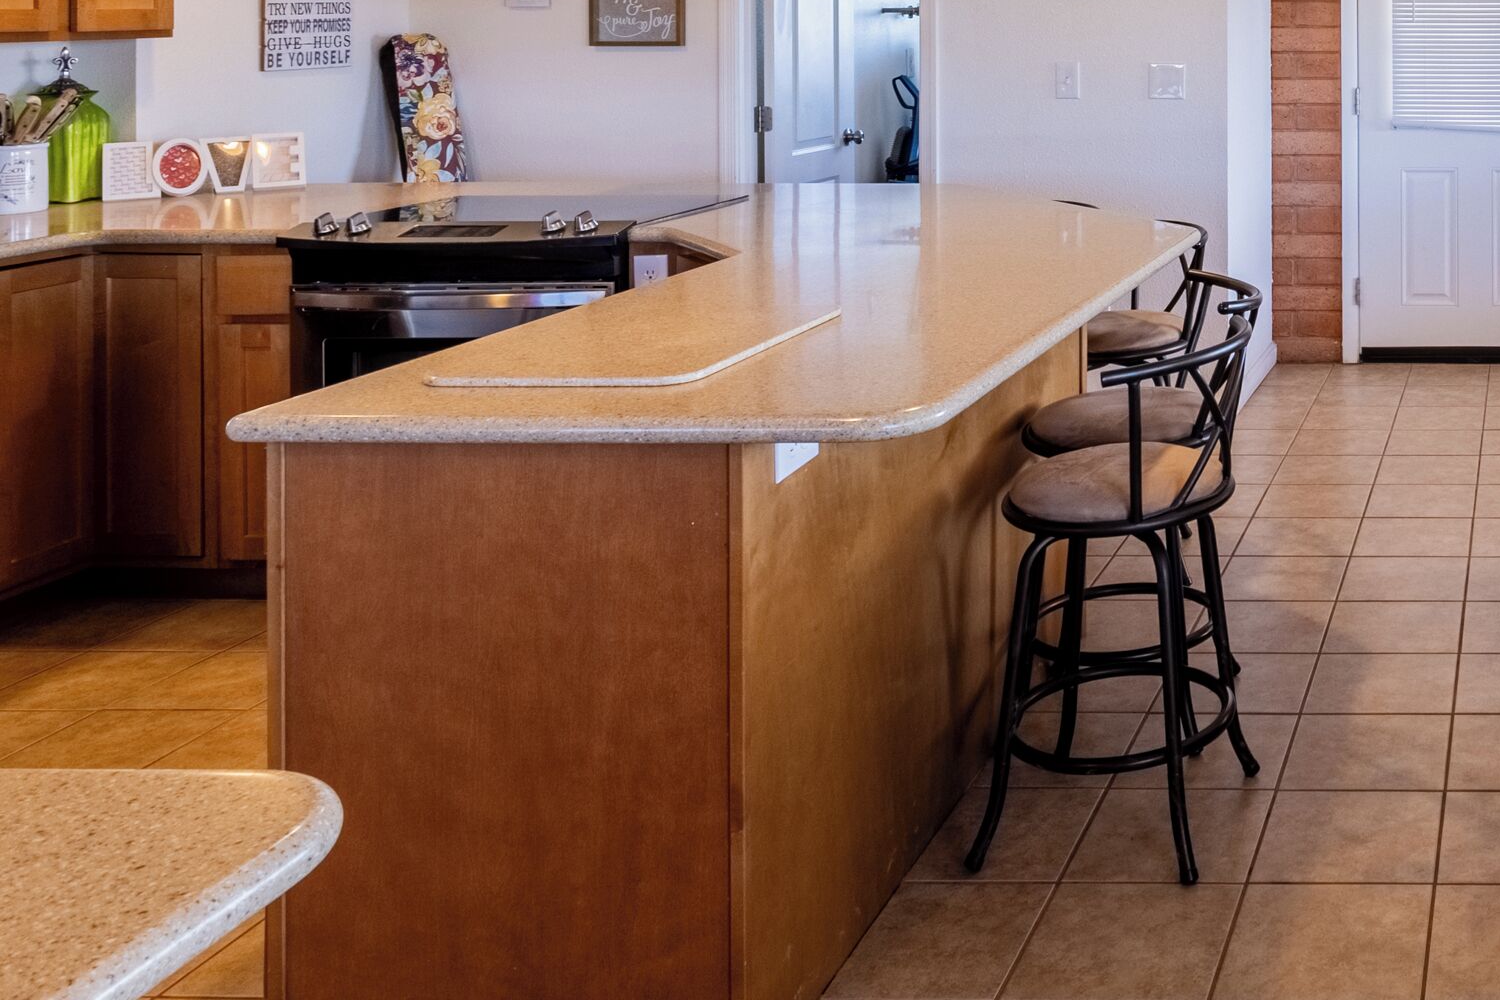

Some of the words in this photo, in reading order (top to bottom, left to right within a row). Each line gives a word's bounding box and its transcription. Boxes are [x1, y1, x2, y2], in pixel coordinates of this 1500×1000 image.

[268, 2, 288, 15] TRY
[290, 2, 313, 15] NEW
[315, 1, 351, 15] THINGS
[267, 19, 288, 34] KEEP
[290, 19, 312, 33] YOUR
[313, 17, 351, 33] PROMISES
[611, 16, 639, 32] pure
[641, 7, 676, 40] Joy
[267, 37, 302, 51] GIVE
[313, 34, 351, 49] HUGS
[267, 53, 283, 68] BE
[288, 49, 351, 67] YOURSELF
[102, 132, 307, 202] LOVE
